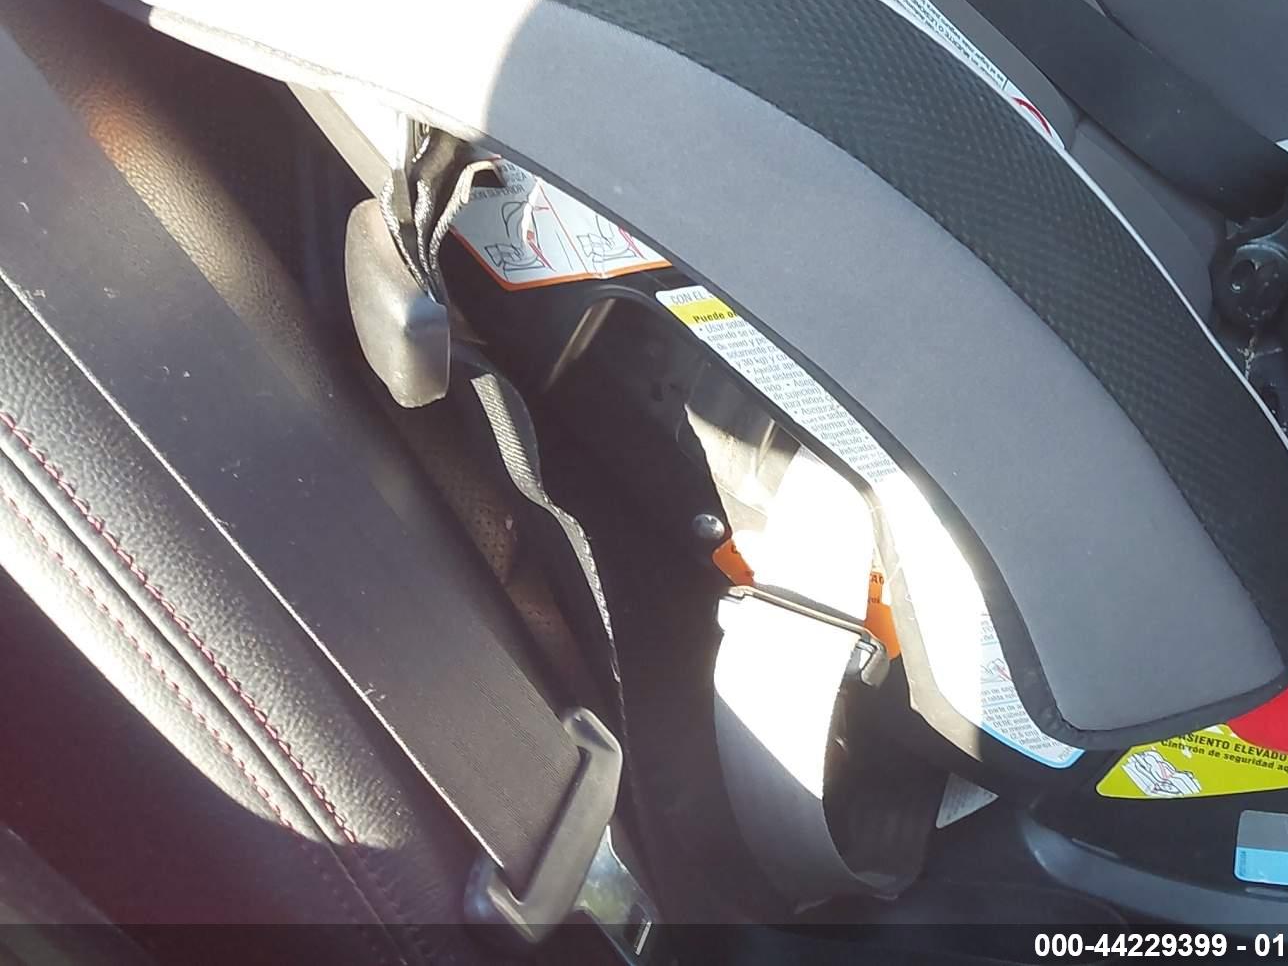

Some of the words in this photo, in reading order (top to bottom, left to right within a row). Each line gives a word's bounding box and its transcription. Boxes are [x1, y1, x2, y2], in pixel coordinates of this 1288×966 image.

[693, 311, 725, 323] Puede
[1208, 749, 1221, 758] de
[1223, 753, 1274, 769] seguridad
[1234, 744, 1288, 762] ELEVADO
